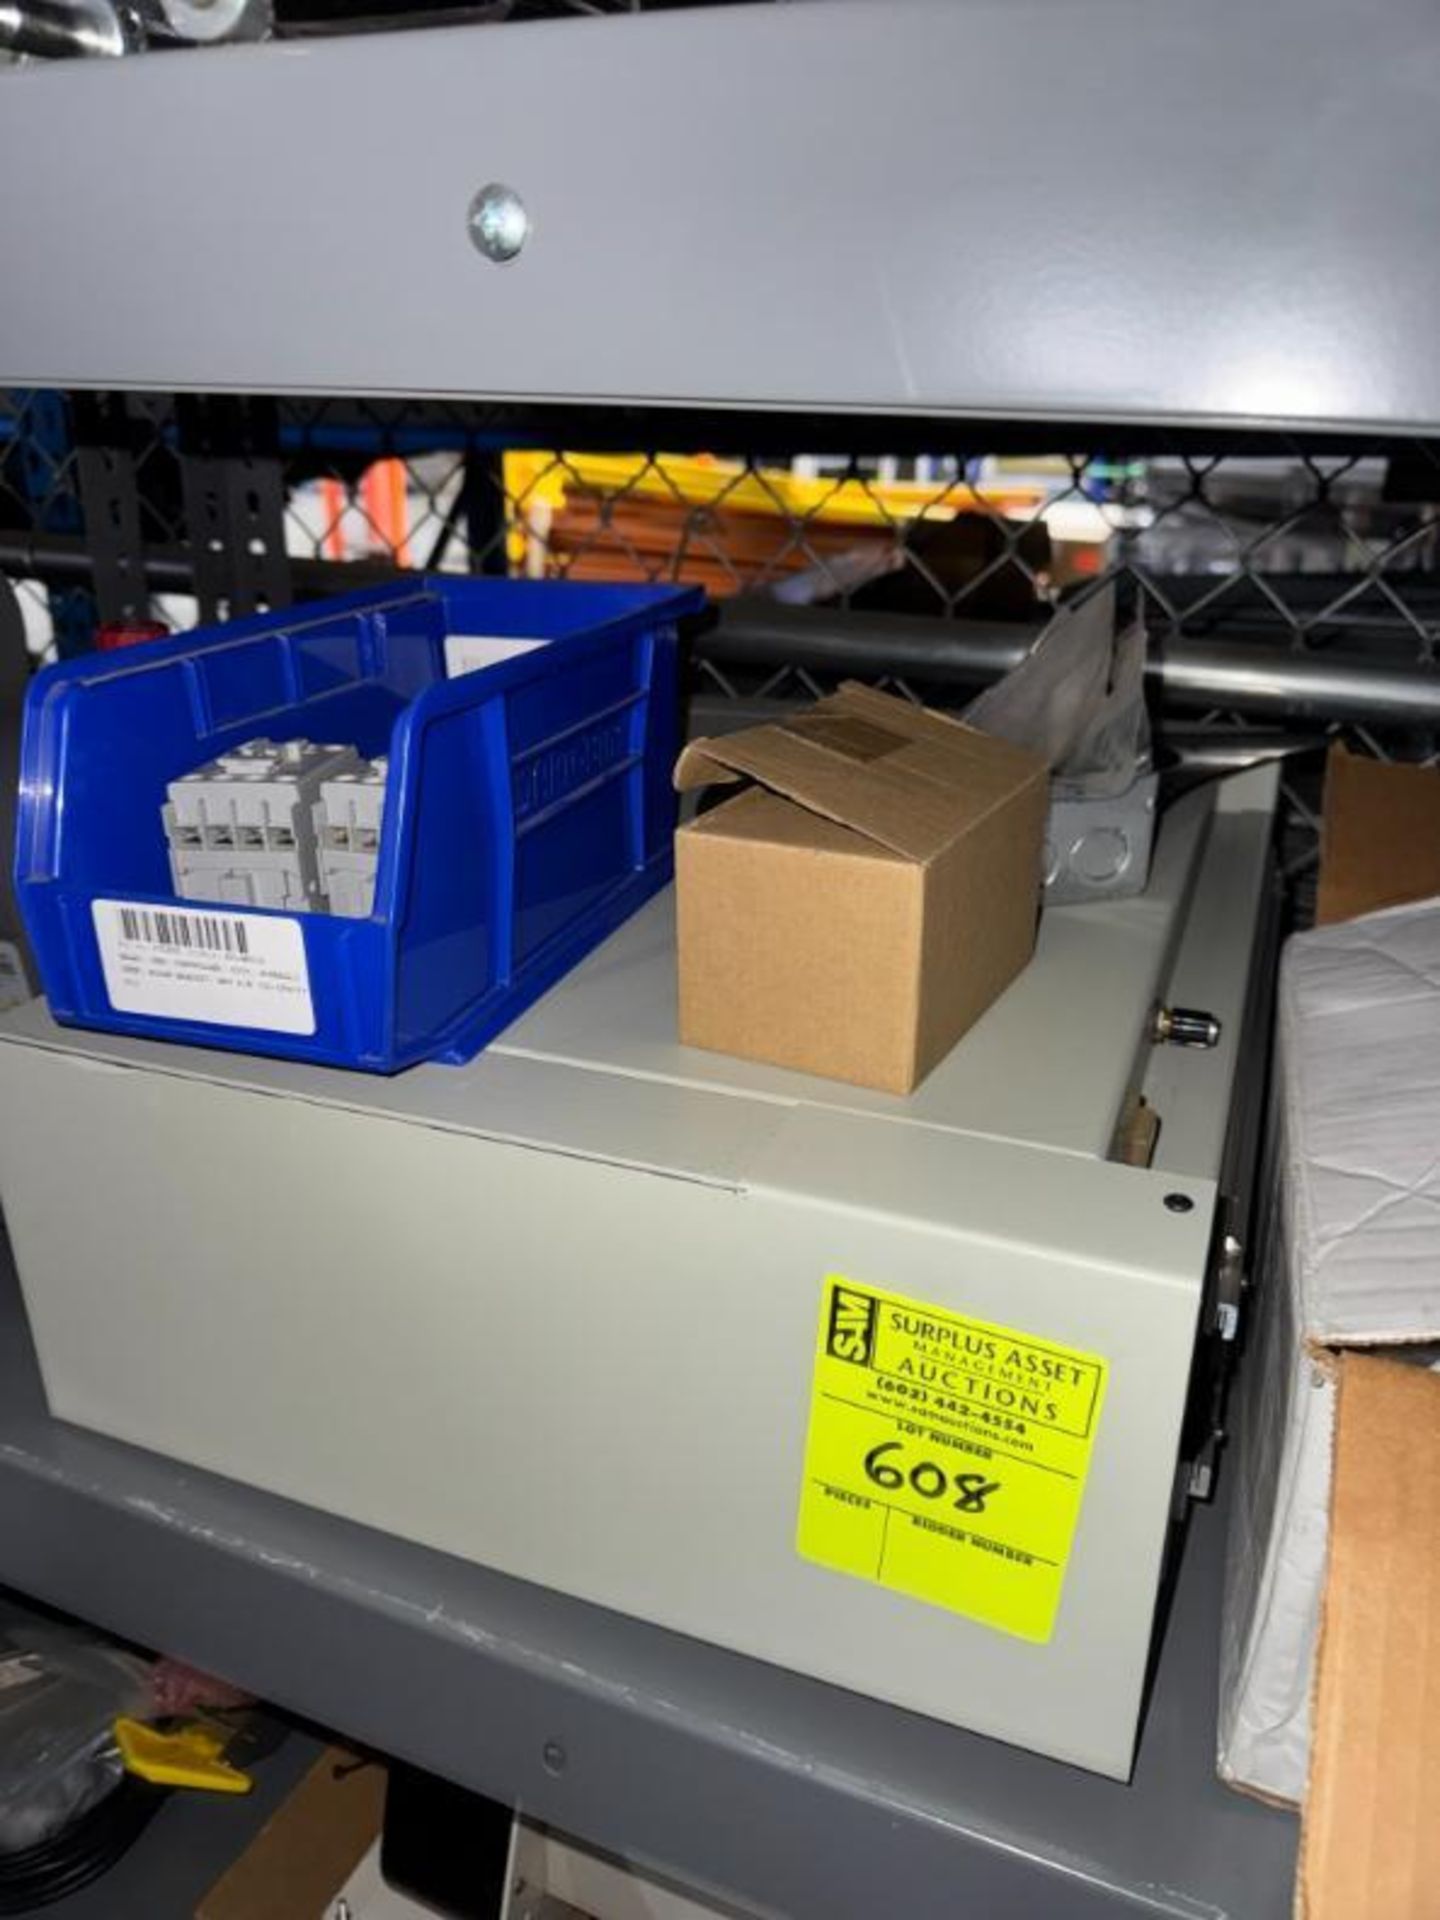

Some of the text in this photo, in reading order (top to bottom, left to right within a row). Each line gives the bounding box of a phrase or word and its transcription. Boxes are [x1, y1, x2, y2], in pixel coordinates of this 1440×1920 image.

[891, 1313, 1086, 1387] SURPLUS ASSET
[913, 1340, 1051, 1392] MANAGEMENT
[877, 1376, 927, 1402] (602)
[899, 1358, 1058, 1421] AUCTIONS
[897, 1420, 993, 1460] LOT NUMBER
[864, 1441, 1001, 1513] 608
[971, 1535, 1034, 1567] NUMBER
